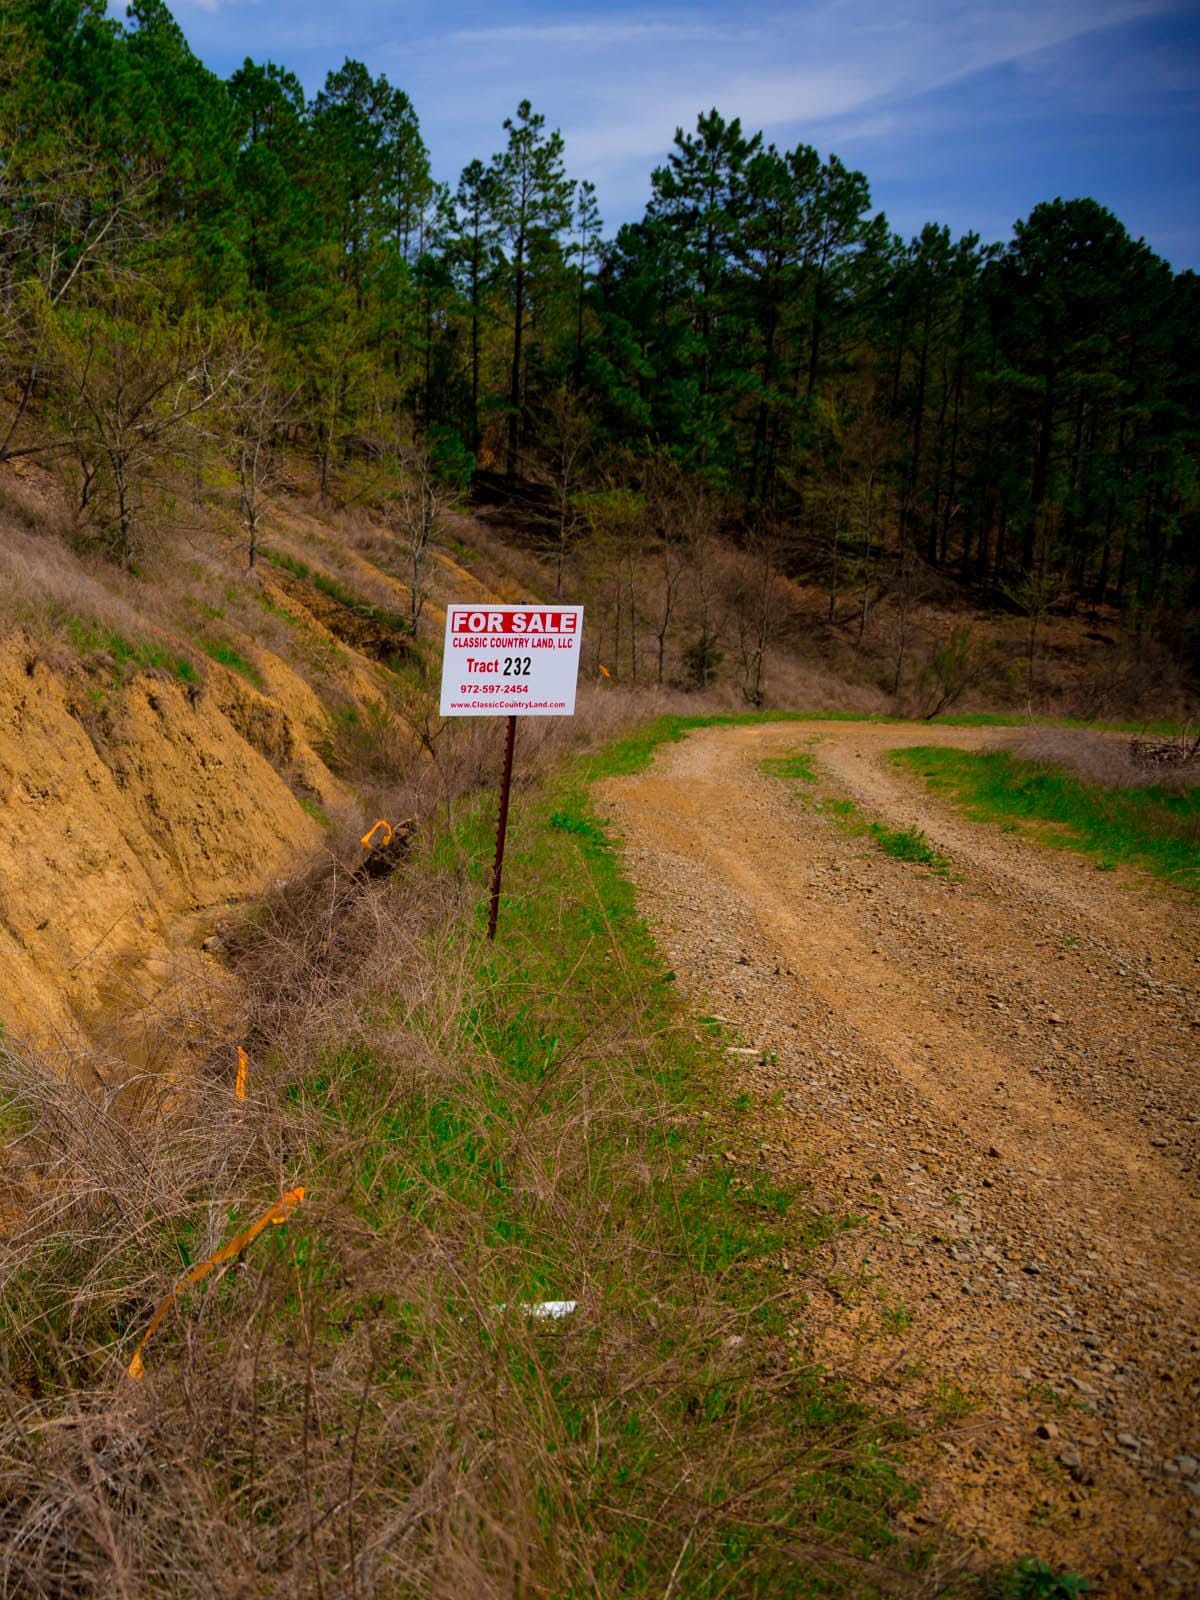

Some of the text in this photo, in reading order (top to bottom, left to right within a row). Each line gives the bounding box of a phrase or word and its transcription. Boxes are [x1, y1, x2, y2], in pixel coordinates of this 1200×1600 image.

[452, 613, 575, 633] FOR SALE
[453, 637, 573, 649] CLASSIC COUNTRY LAND, LLC
[466, 657, 532, 676] Tract 232
[460, 685, 529, 694] 972-597-2454
[450, 701, 566, 709] www.ClassicCountryLand.com
